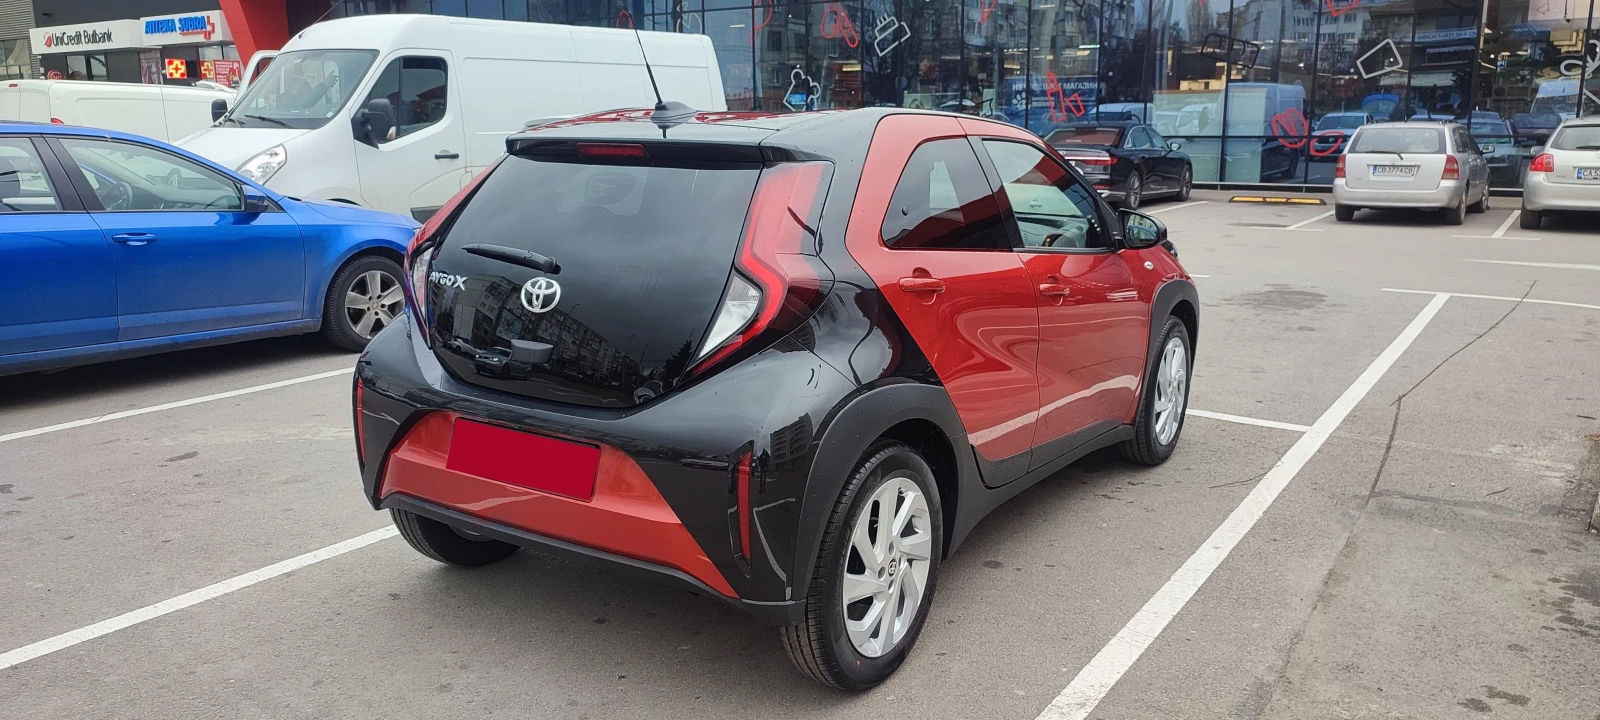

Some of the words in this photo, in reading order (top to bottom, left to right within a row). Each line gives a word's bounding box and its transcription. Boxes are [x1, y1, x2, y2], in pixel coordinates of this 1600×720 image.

[52, 31, 83, 47] UniCredit
[83, 28, 113, 44] Bulbank
[1063, 82, 1098, 90] МАГАЗИН
[429, 271, 453, 287] AYGO
[453, 274, 468, 291] X
